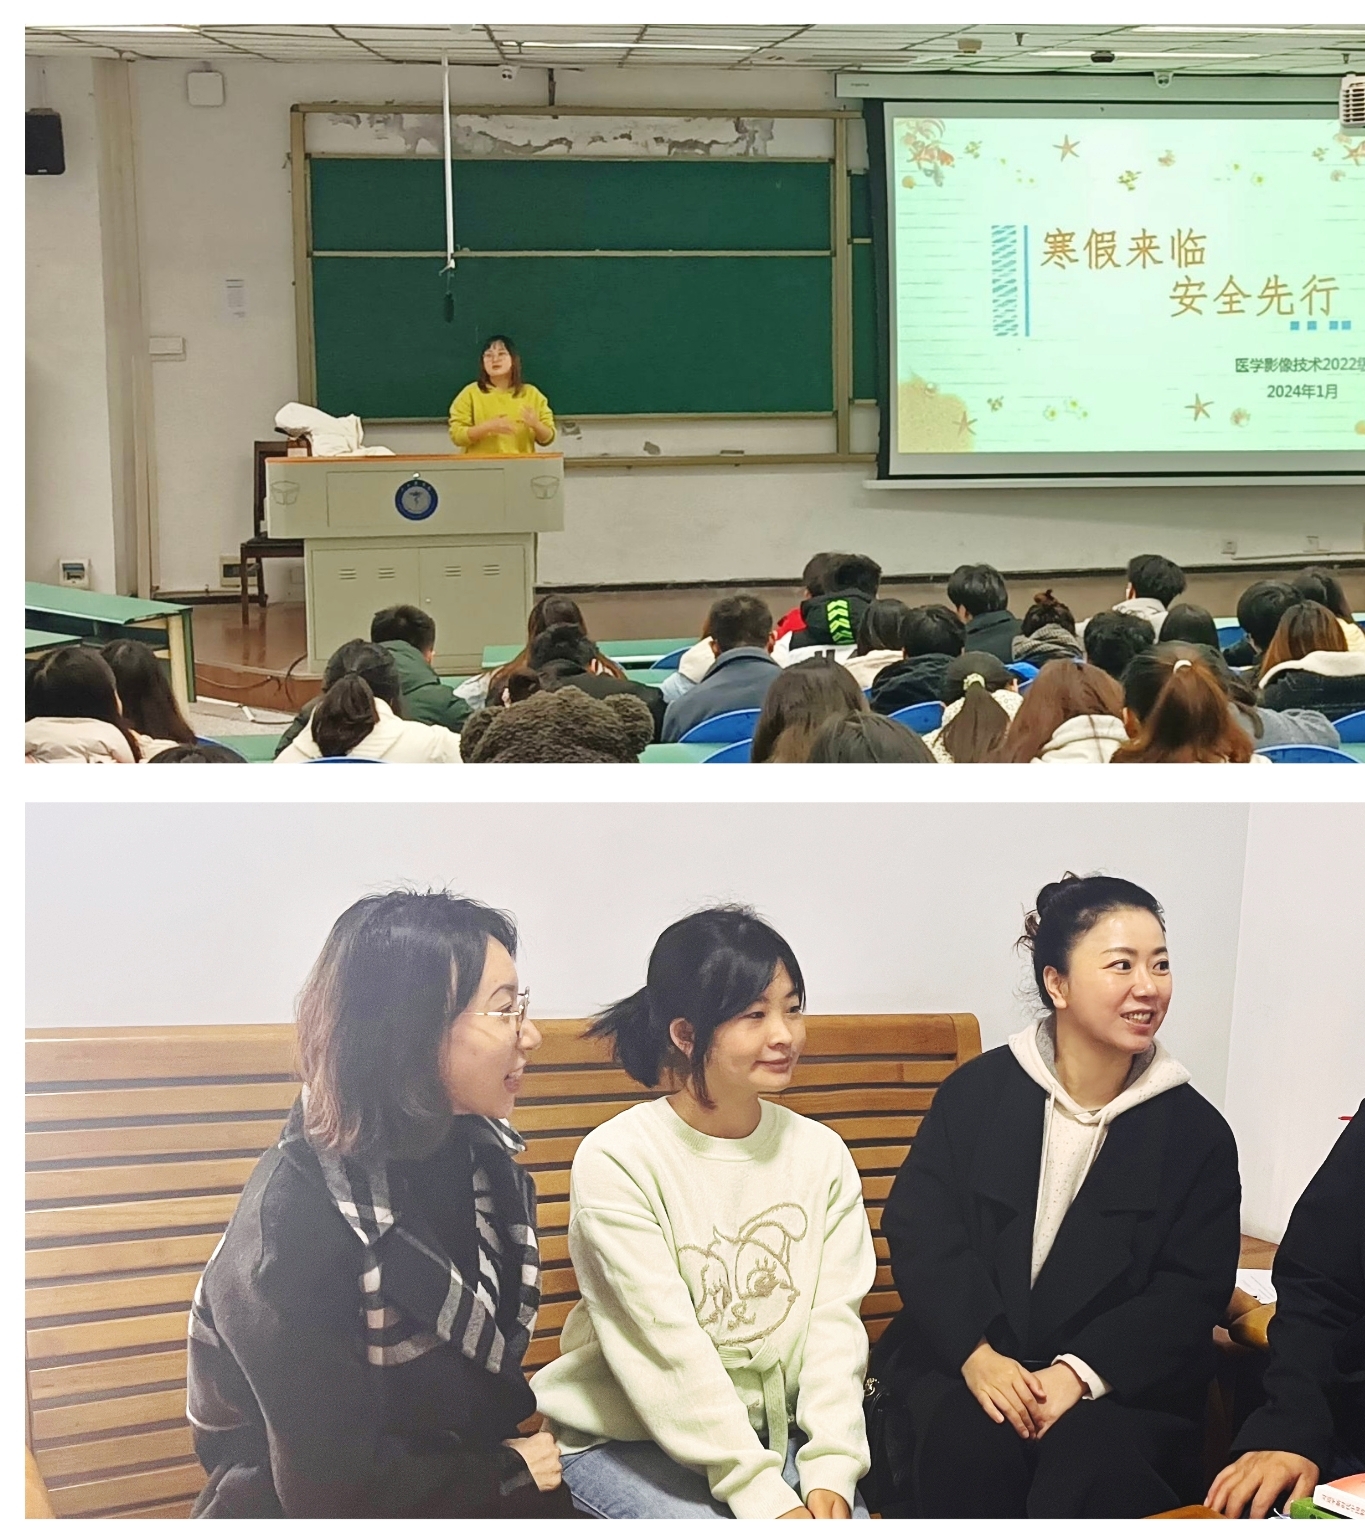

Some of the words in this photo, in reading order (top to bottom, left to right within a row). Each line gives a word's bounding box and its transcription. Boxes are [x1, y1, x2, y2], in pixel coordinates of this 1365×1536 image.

[1040, 226, 1208, 271] 寒假来临
[1168, 274, 1341, 318] 安全先行
[1266, 383, 1339, 400] 2024年1月
